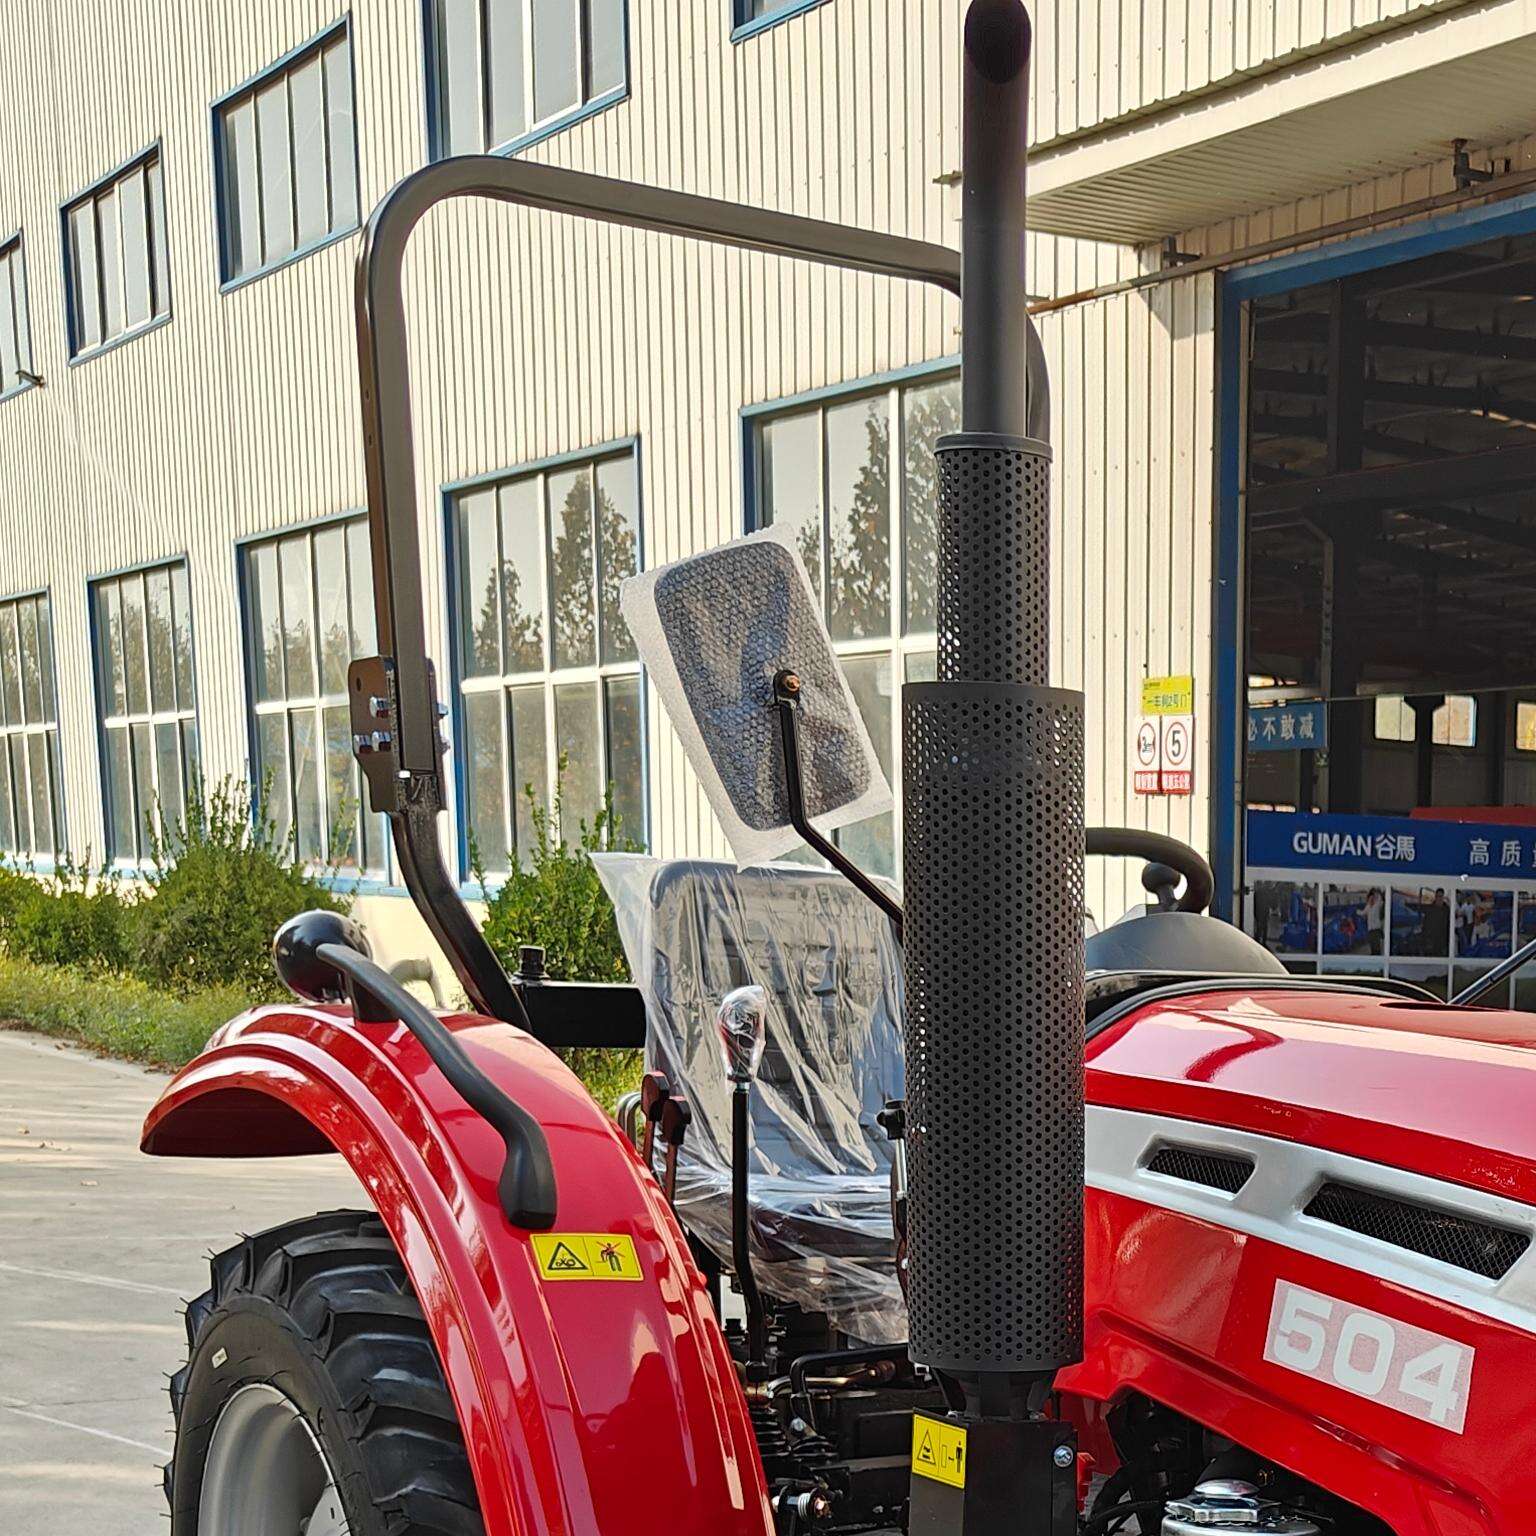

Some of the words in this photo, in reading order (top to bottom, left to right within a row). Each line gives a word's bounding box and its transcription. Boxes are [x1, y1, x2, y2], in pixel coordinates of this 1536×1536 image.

[1171, 729, 1182, 758] 5
[1292, 831, 1372, 857] GUMAN
[1375, 833, 1416, 862] 谷馬
[1273, 1288, 1464, 1423] 504
